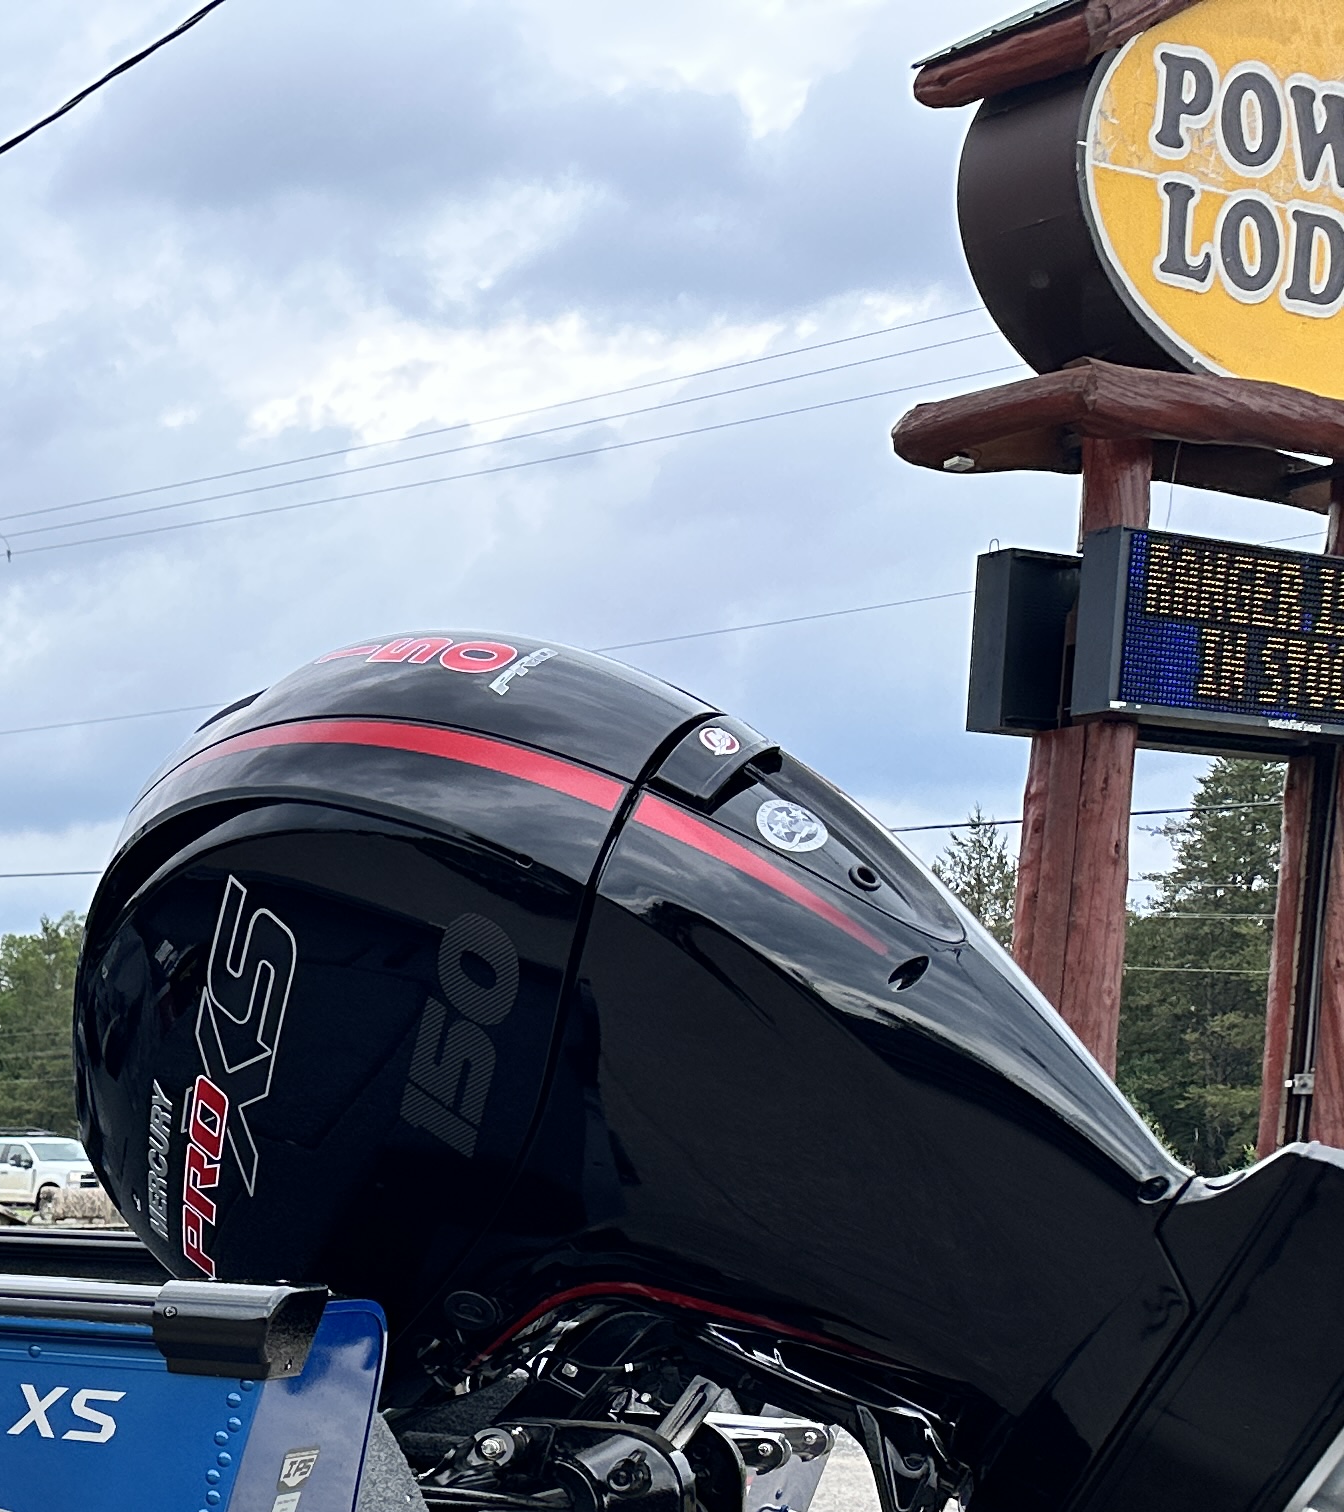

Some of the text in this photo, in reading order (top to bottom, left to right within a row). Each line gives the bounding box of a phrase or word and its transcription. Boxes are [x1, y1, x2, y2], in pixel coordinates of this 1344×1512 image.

[1145, 542, 1304, 632] RANGER
[1197, 627, 1248, 699] IN
[399, 911, 521, 1160] 150
[147, 1078, 175, 1243] MERCURY
[182, 1073, 230, 1280] PRO
[6, 1383, 127, 1445] XS
[282, 1457, 315, 1480] IPS
